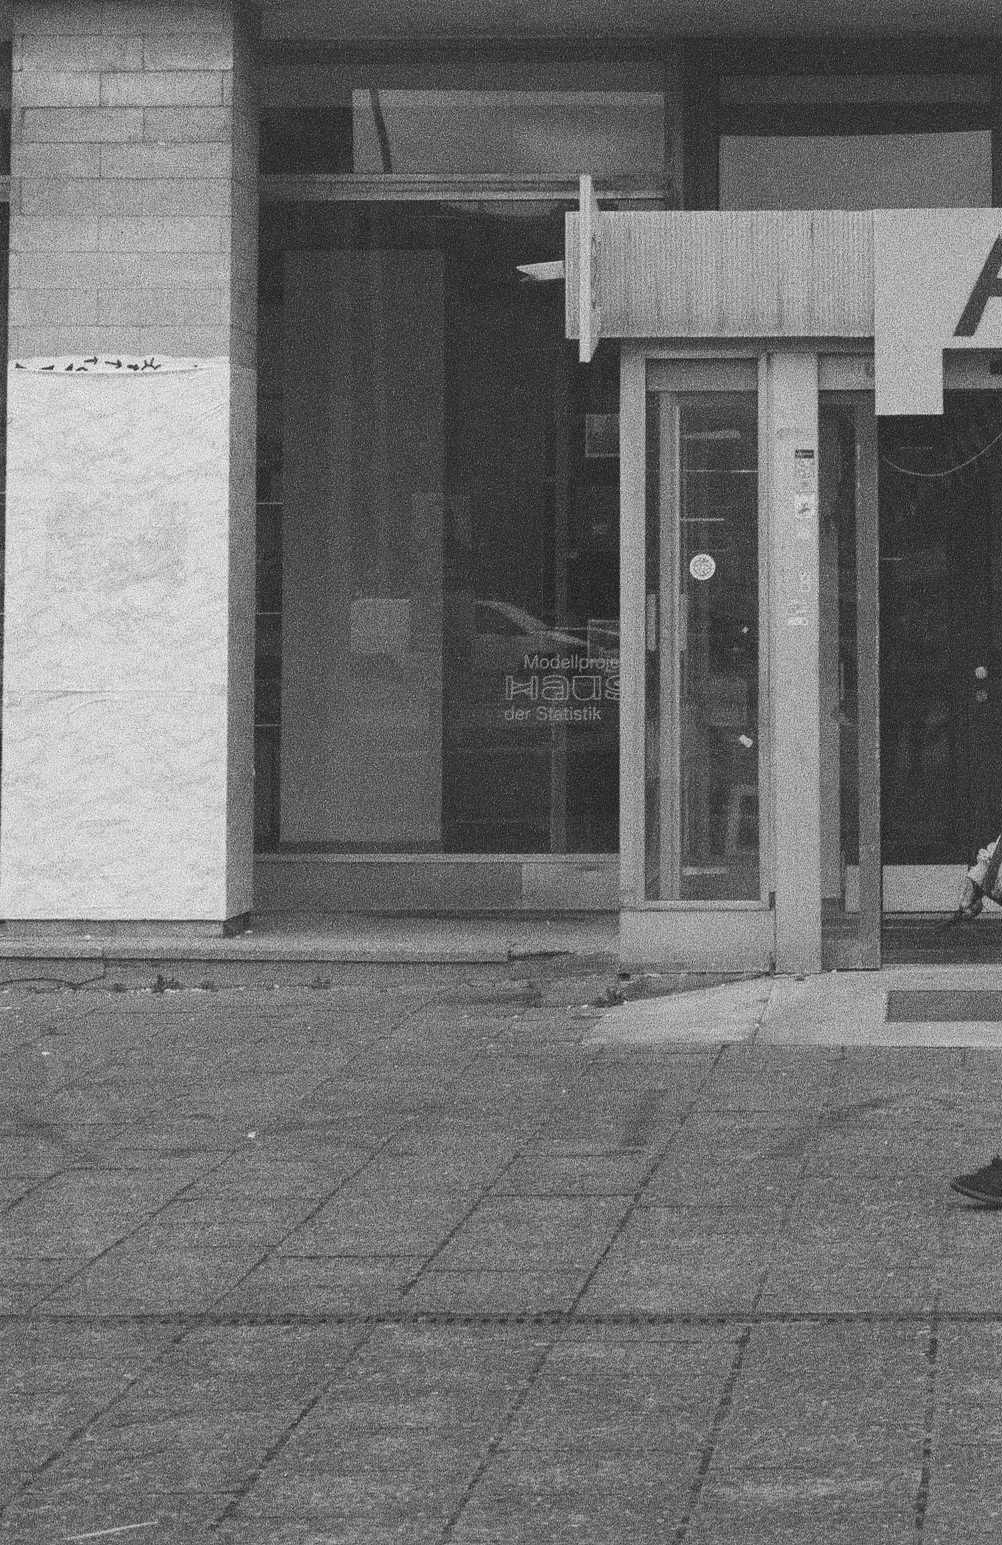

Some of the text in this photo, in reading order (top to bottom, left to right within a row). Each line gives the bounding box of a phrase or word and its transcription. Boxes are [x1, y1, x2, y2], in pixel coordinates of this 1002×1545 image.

[523, 654, 619, 672] Modellproje
[504, 706, 602, 721] der Statistik
